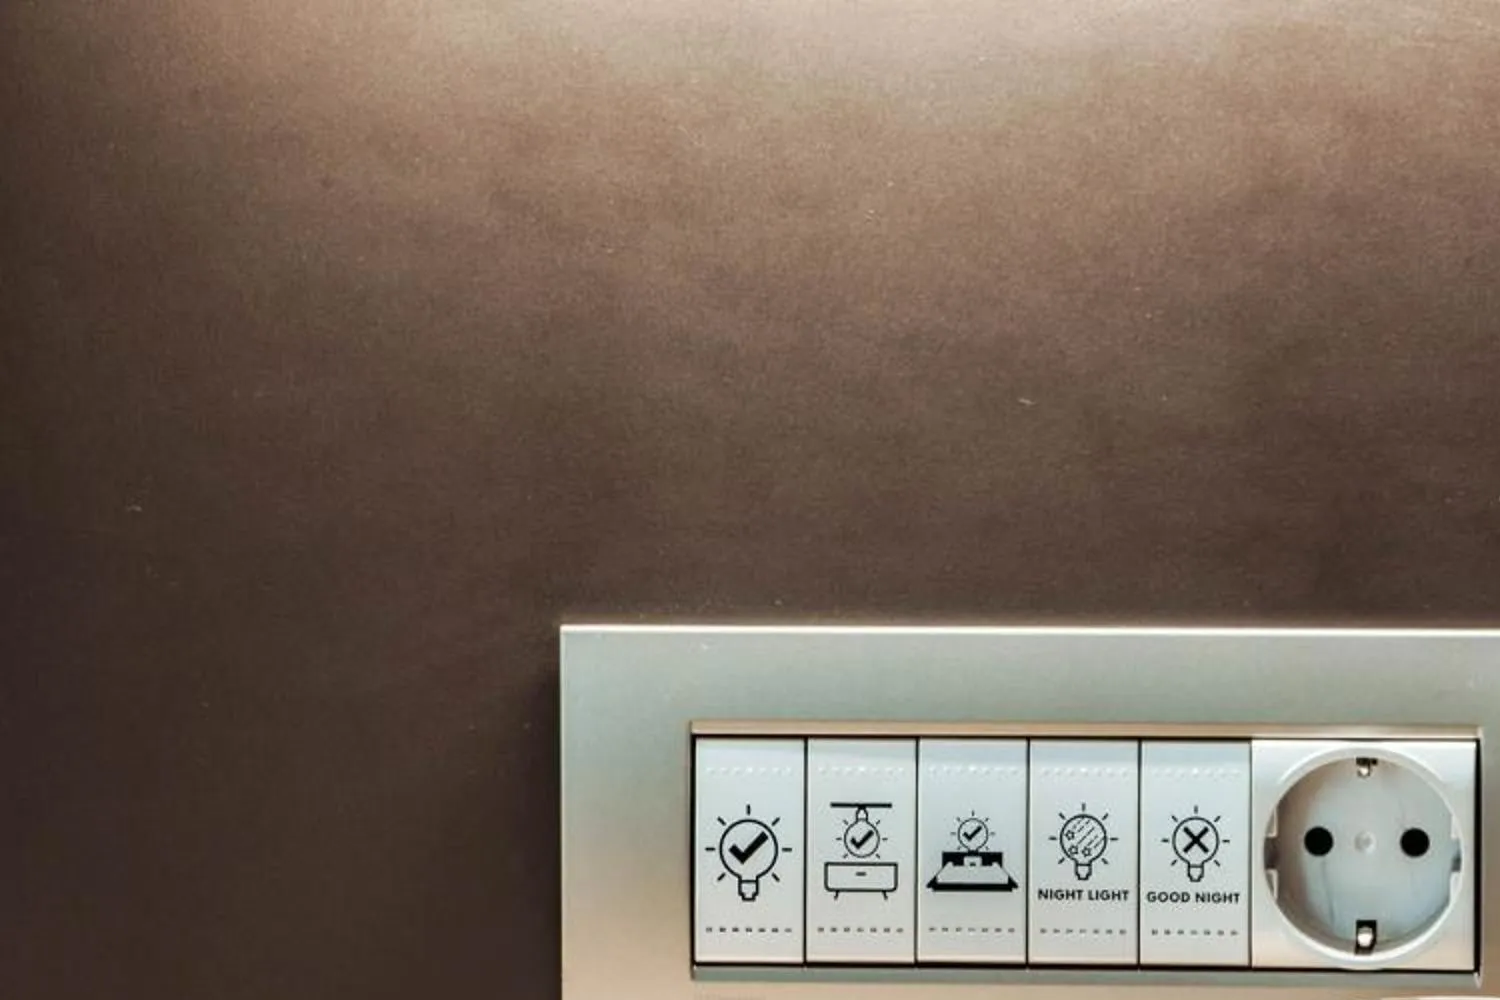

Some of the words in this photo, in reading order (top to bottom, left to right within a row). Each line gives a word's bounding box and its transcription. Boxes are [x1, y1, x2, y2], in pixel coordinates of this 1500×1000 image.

[1037, 888, 1083, 901] NIGHT
[1087, 889, 1129, 902] LIGHT
[1146, 891, 1191, 904] GOOD
[1195, 892, 1240, 905] NIGHT
